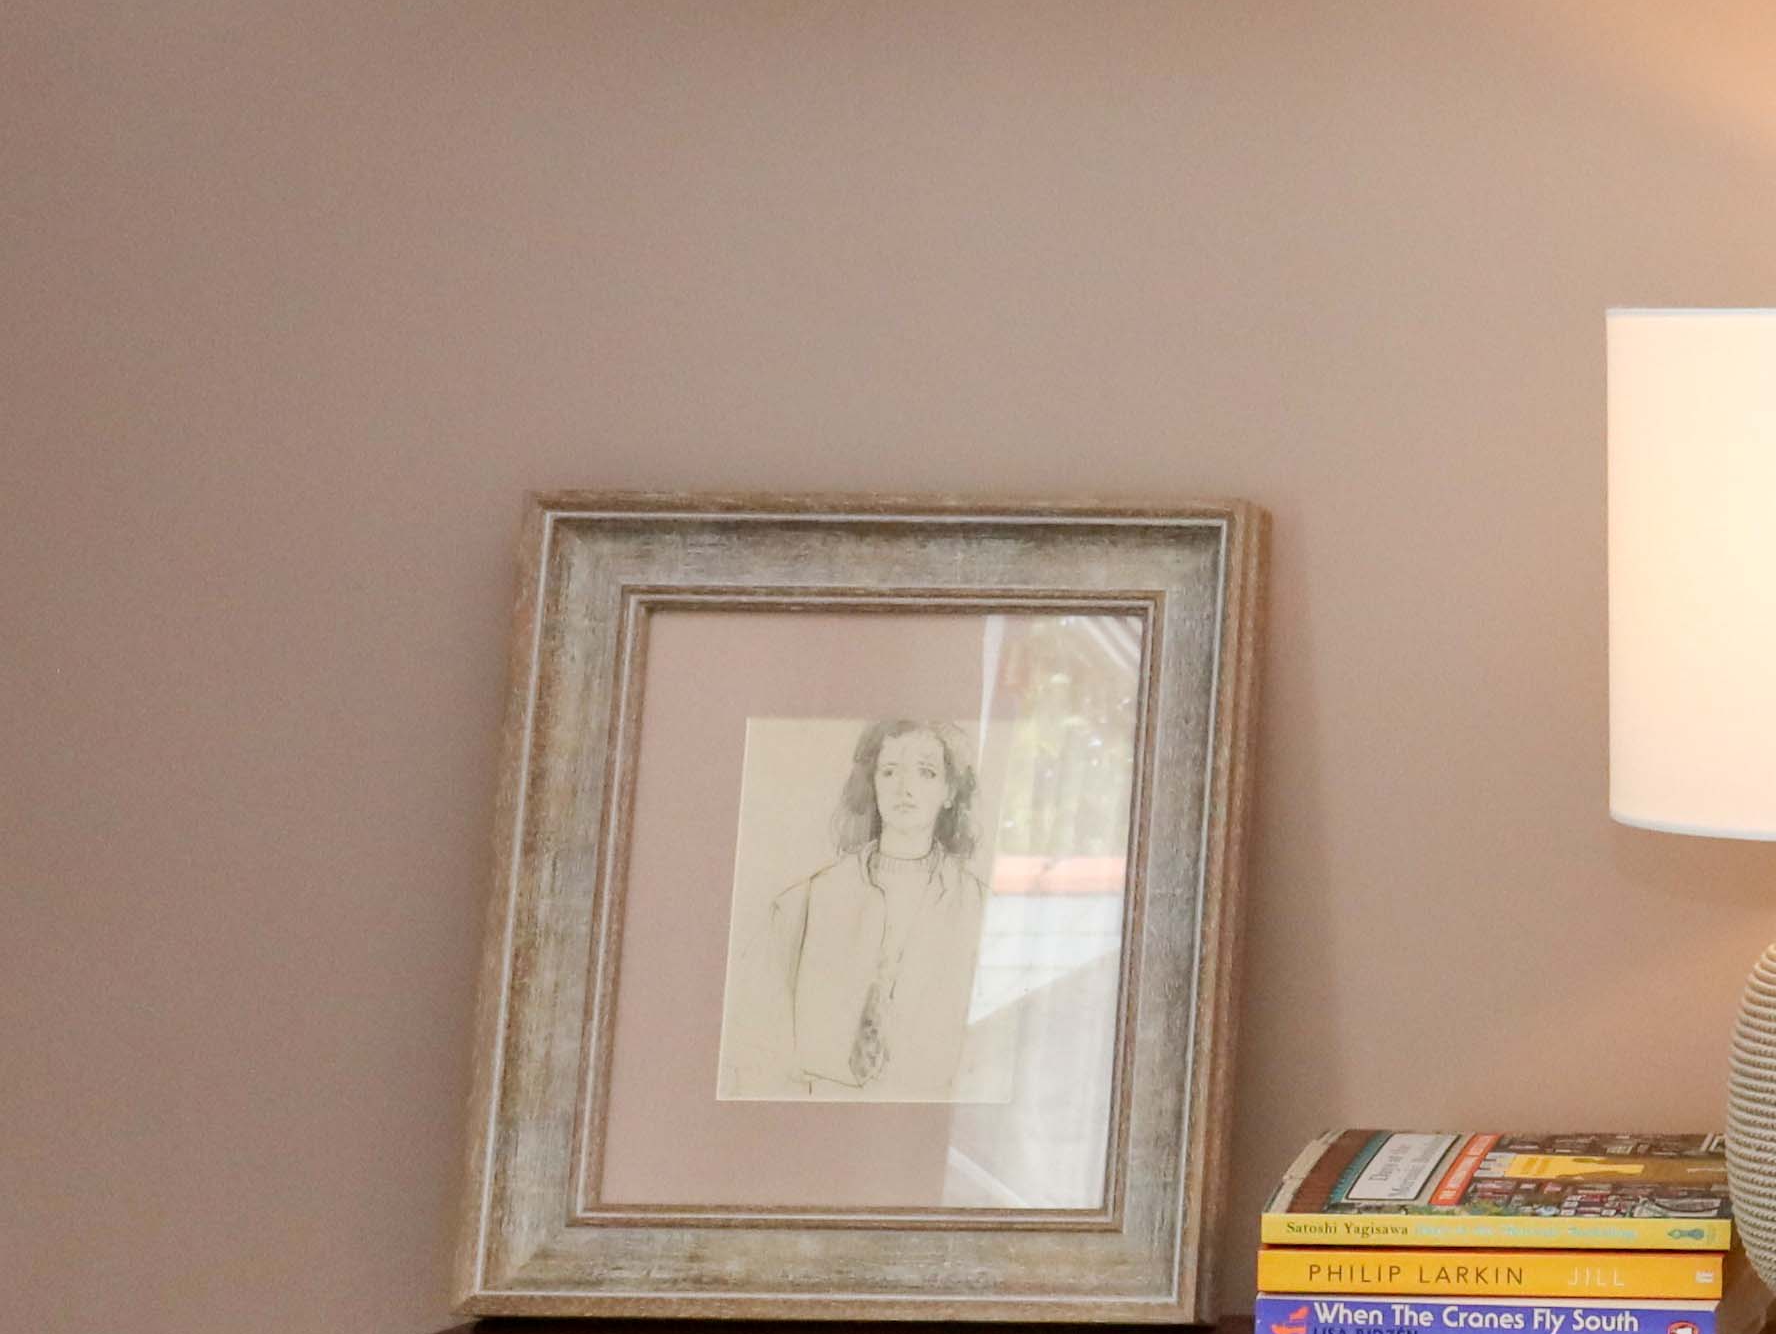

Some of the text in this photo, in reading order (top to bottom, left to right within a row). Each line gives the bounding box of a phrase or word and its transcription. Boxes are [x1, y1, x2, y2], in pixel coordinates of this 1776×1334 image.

[1286, 1221, 1409, 1238] Satoshi Yagisawa
[1308, 1264, 1625, 1287] PHILIP LARKIN JILL
[1313, 1301, 1384, 1326] When
[1391, 1303, 1434, 1327] The
[1442, 1306, 1525, 1331] Cranes
[1571, 1308, 1639, 1333] South
